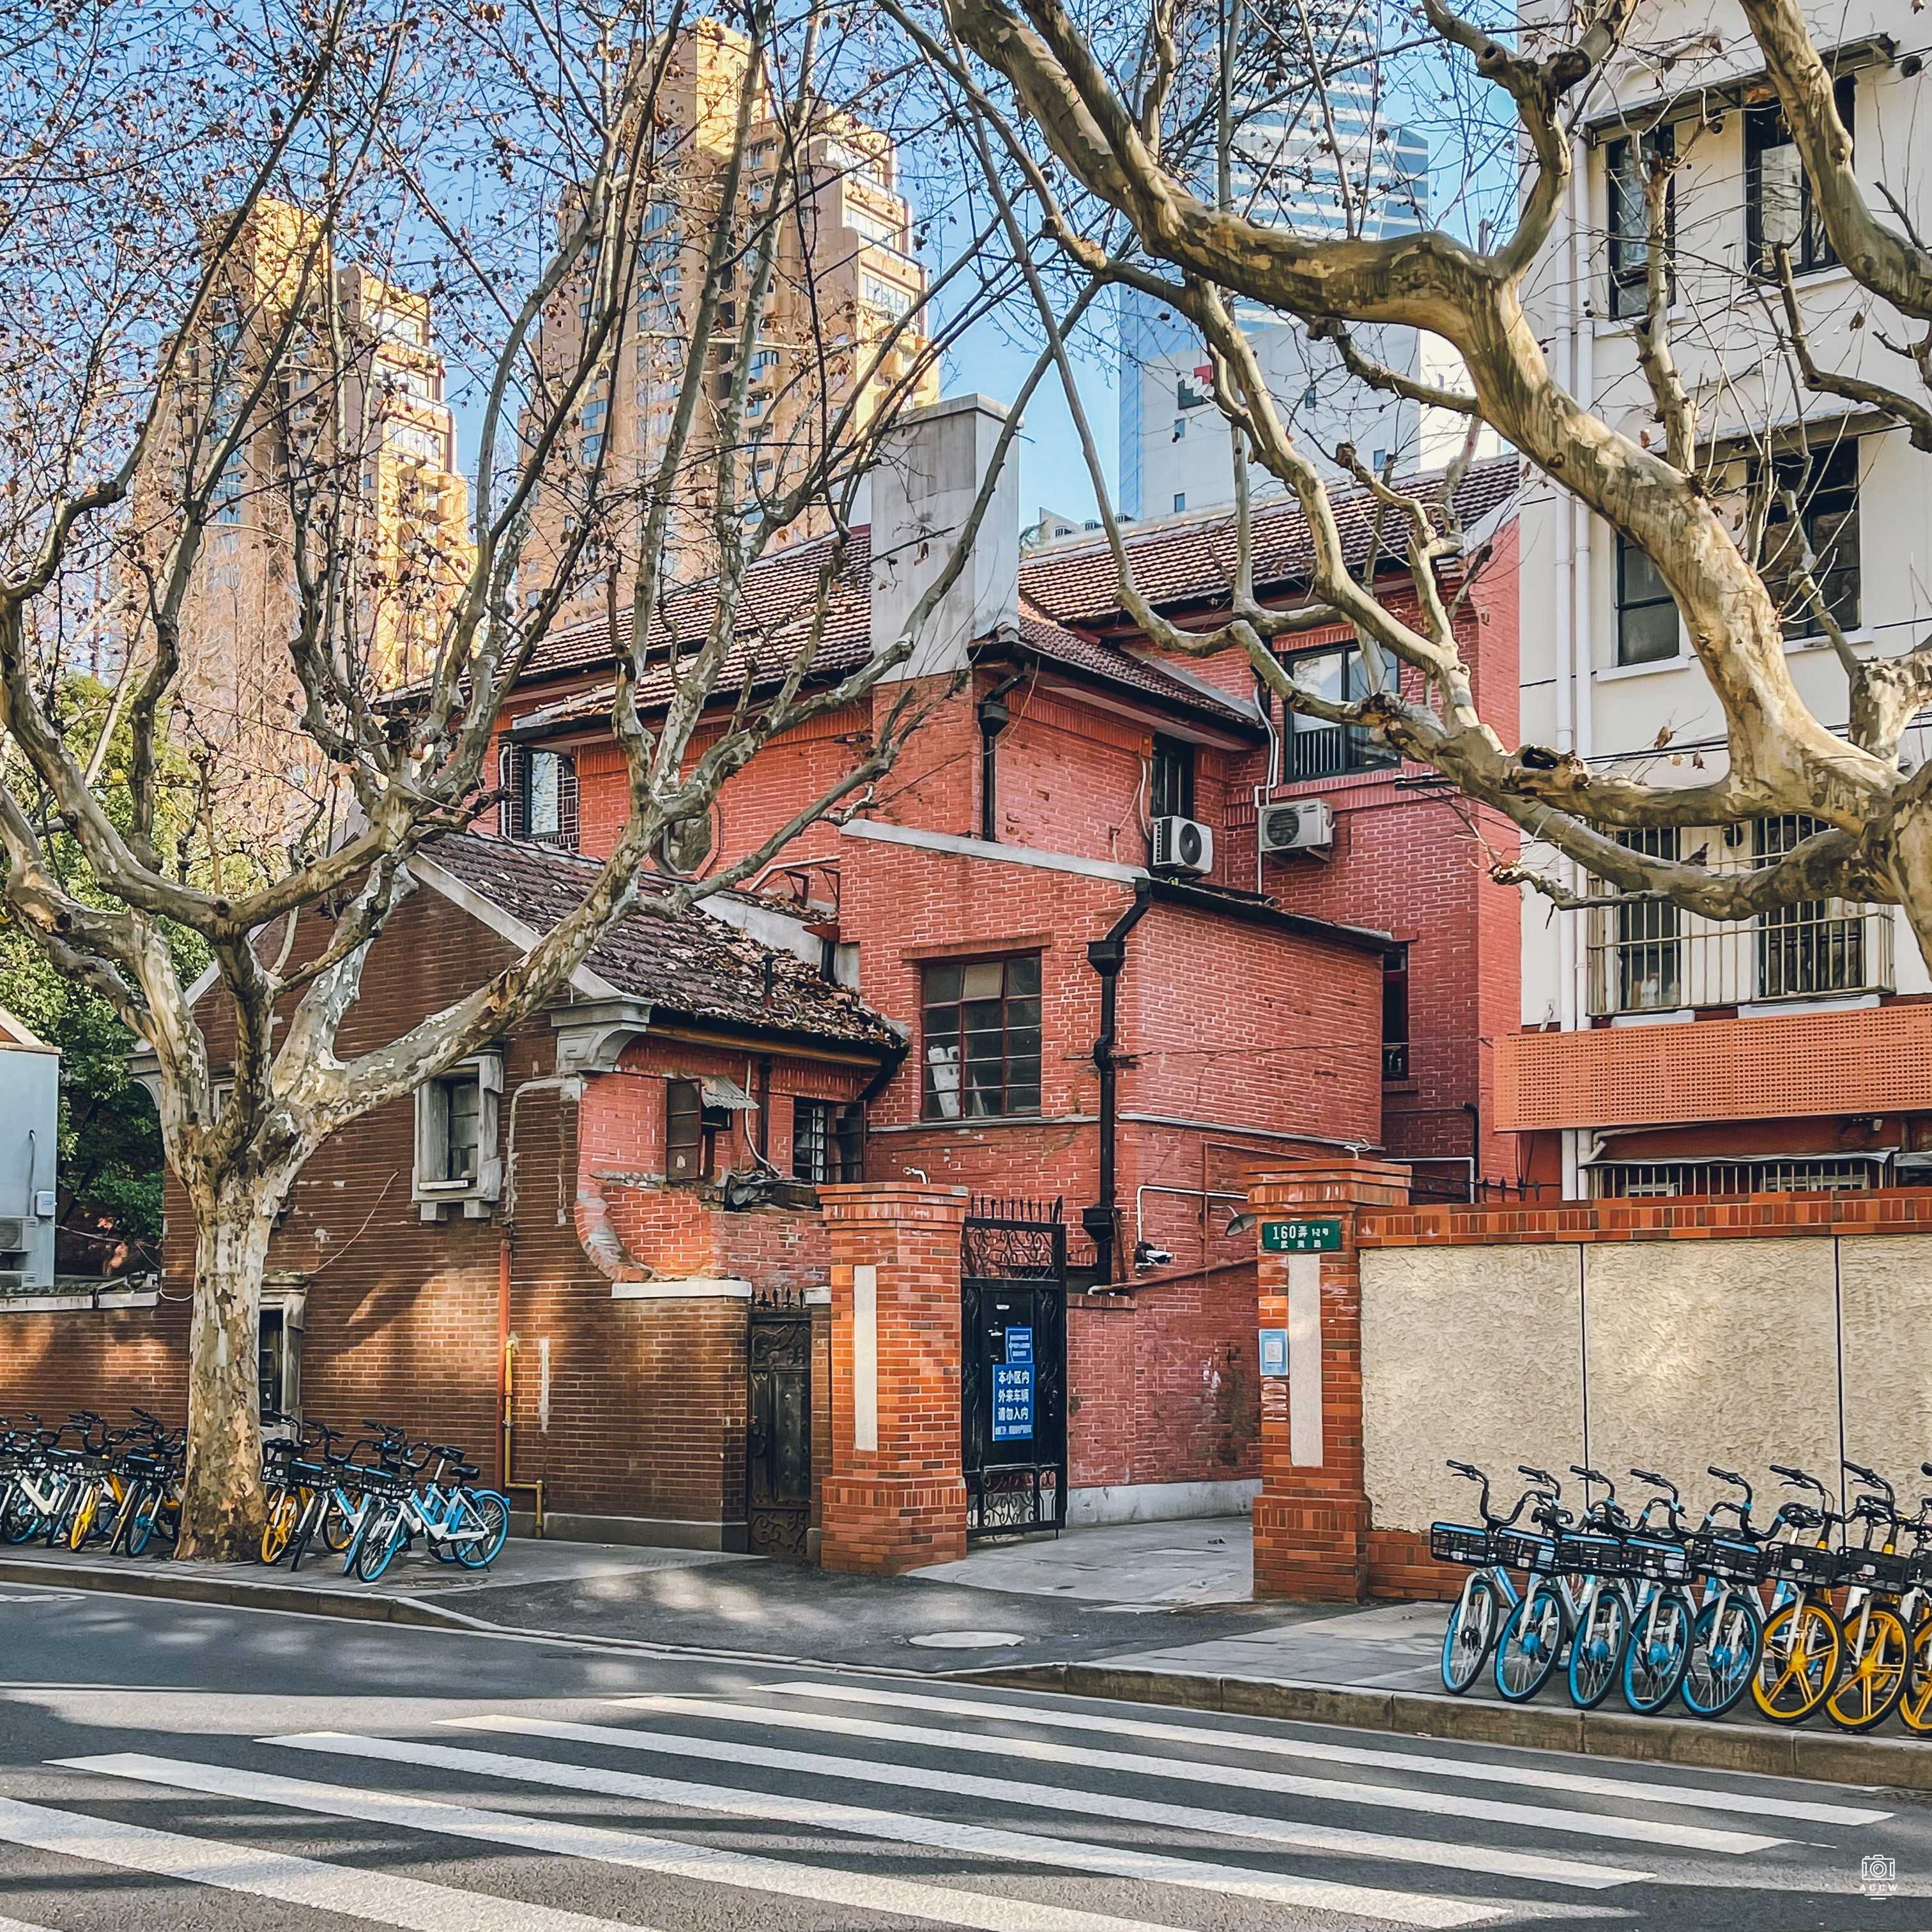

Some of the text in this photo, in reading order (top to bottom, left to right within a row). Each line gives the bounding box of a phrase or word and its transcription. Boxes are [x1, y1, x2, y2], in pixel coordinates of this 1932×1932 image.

[998, 1370, 1029, 1384] 本小区内
[998, 1389, 1029, 1403] 外来车辆
[998, 1407, 1029, 1421] 请勿入内
